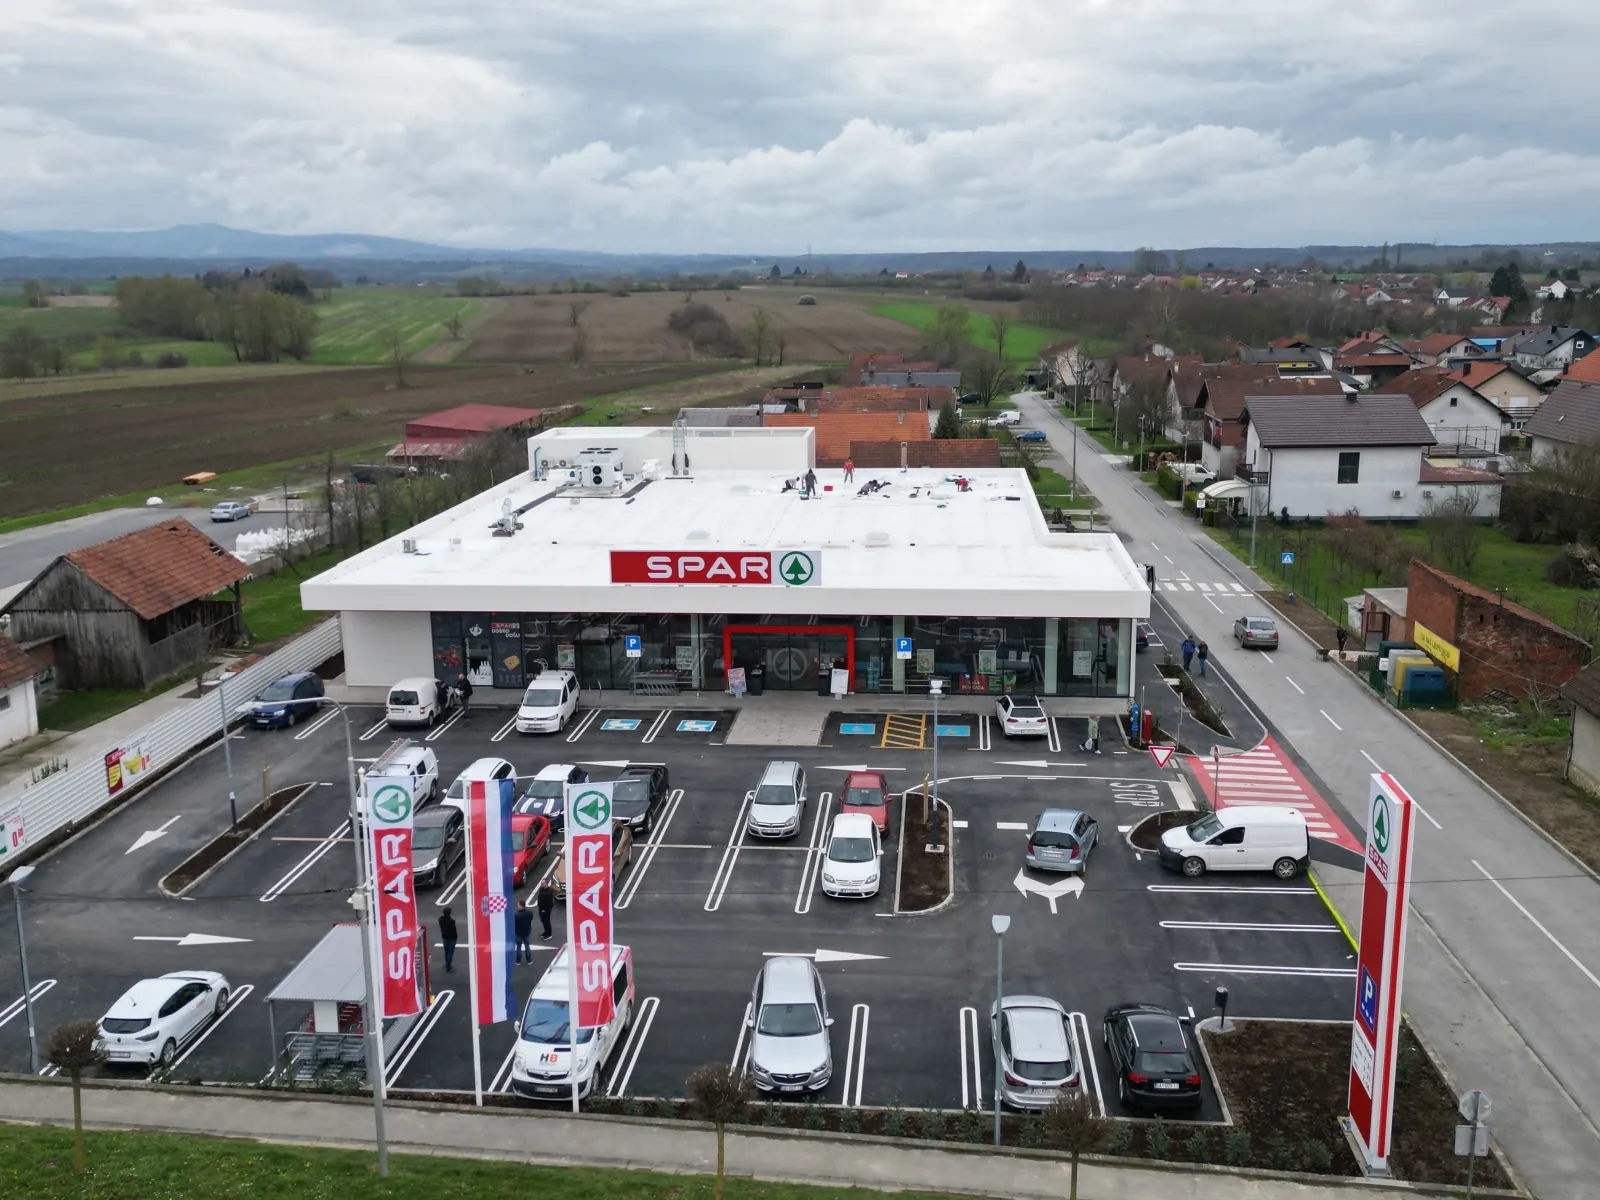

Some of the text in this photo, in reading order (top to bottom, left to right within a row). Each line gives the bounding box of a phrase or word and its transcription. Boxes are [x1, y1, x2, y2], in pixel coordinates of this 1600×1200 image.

[646, 556, 769, 579] SPAR
[630, 639, 637, 648] P
[900, 640, 908, 649] P
[1109, 782, 1164, 807] STOP
[1369, 847, 1388, 876] SPAR
[381, 833, 411, 980] SPAR
[578, 840, 608, 992] SPAR
[1365, 975, 1373, 1003] P
[539, 1053, 560, 1063] HB
